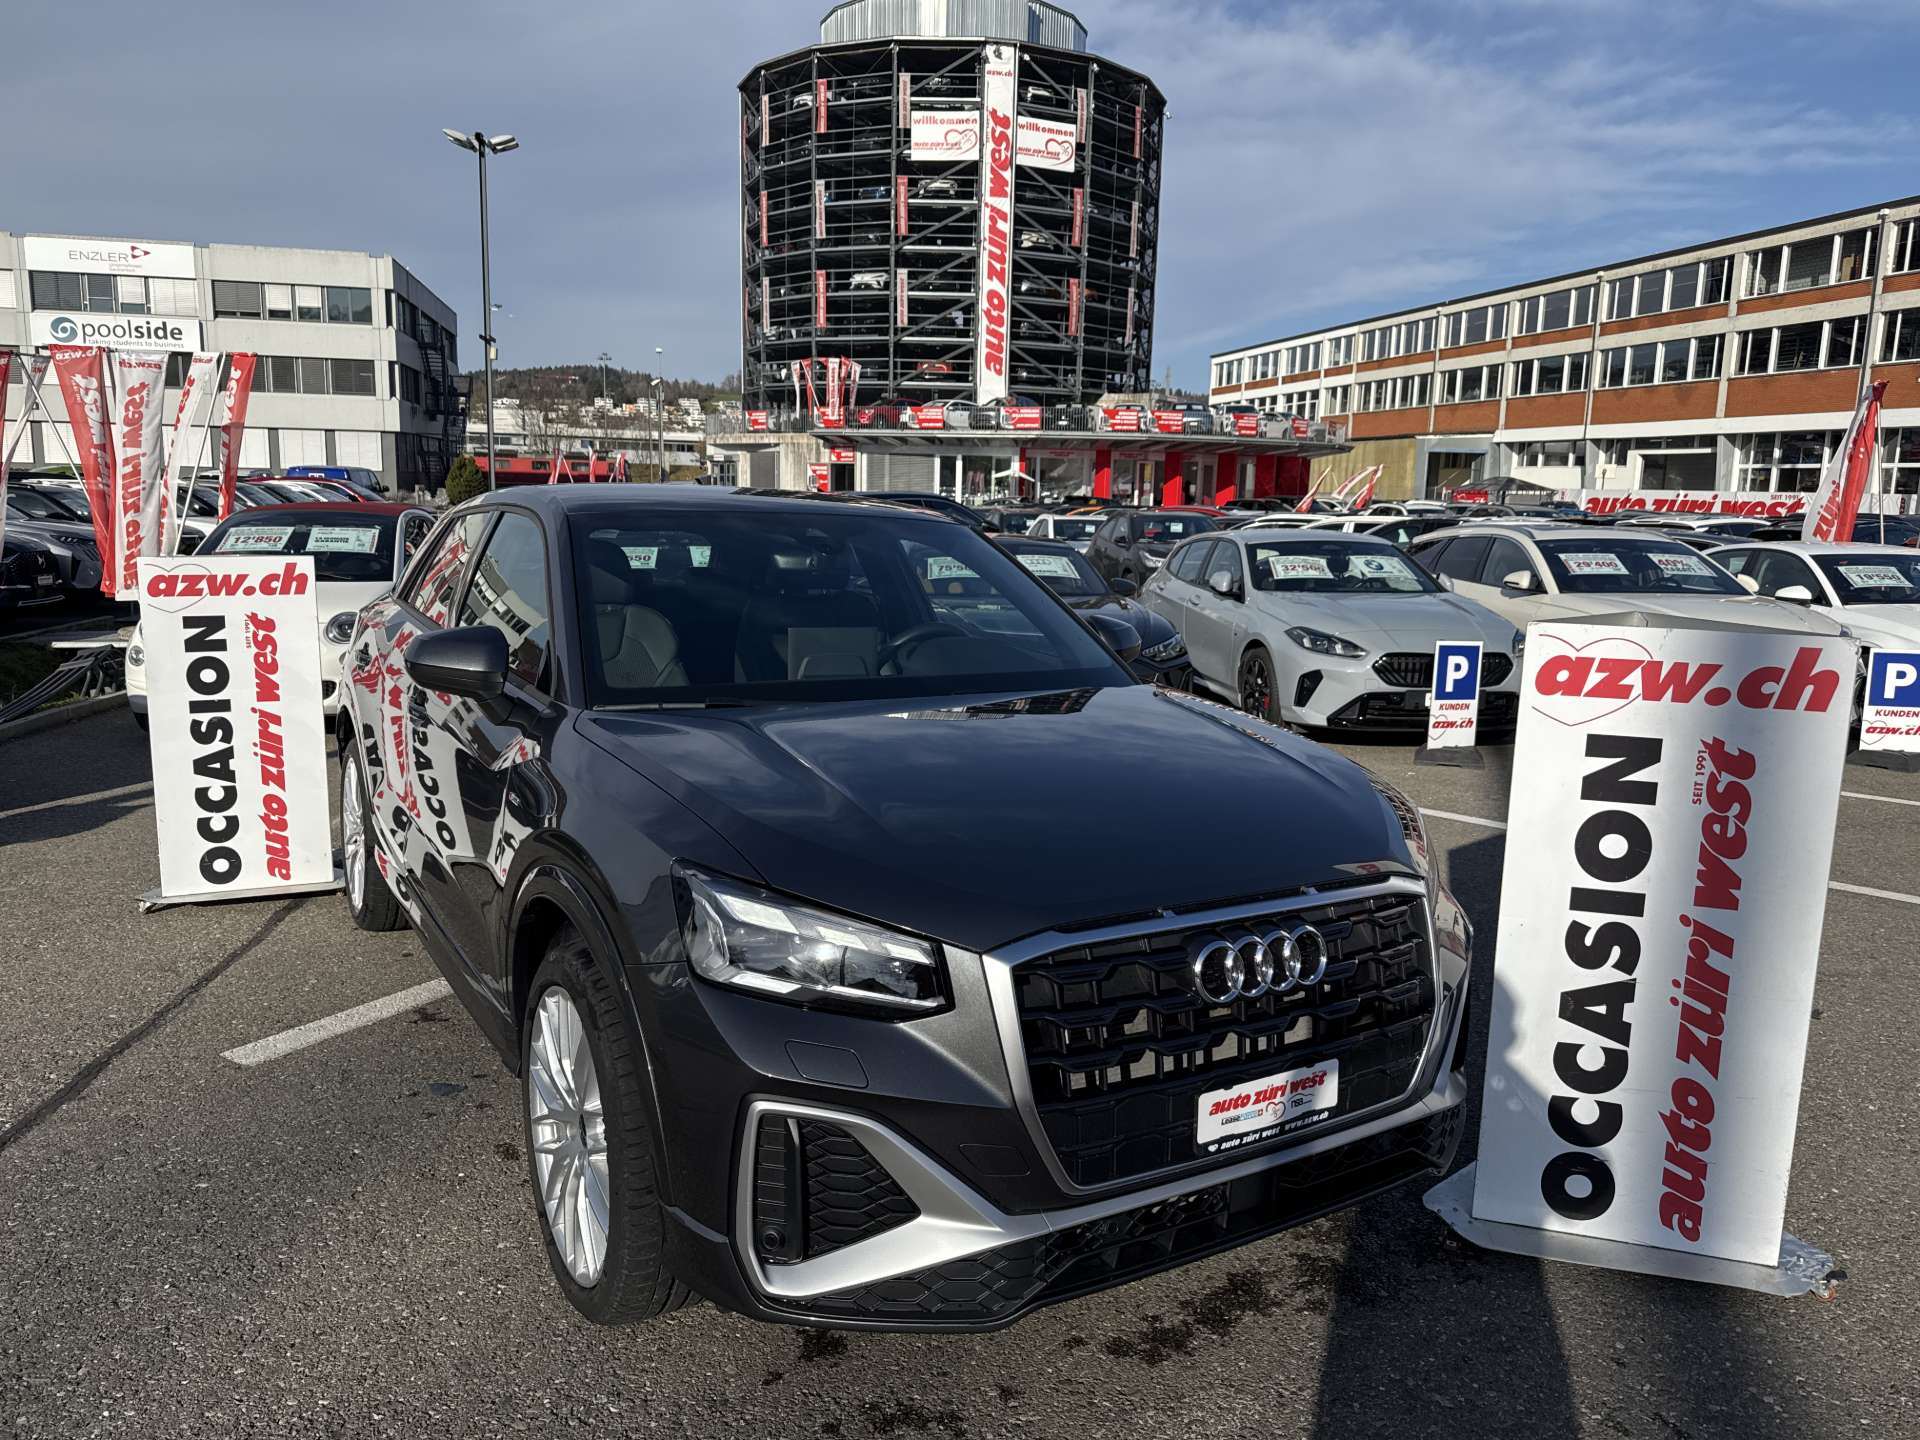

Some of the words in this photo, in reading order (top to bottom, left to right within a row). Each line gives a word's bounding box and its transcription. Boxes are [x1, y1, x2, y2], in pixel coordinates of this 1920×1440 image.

[912, 115, 978, 125] willkommen
[1018, 121, 1075, 138] willkommen
[988, 107, 1012, 199] west
[68, 250, 129, 263] ENZLER
[82, 319, 183, 344] poolside
[88, 338, 111, 347] taking
[113, 339, 142, 347] students
[154, 340, 184, 349] business
[984, 289, 1006, 377] auto
[1584, 494, 1646, 515] auto
[1720, 495, 1805, 517] west
[233, 535, 283, 544] 12'850
[146, 561, 309, 598] azw.ch
[245, 612, 281, 703] west
[1445, 655, 1469, 693] P
[1535, 647, 1840, 713] azw.ch
[1884, 662, 1918, 699] P
[1432, 718, 1474, 729] azw.ch
[1439, 703, 1471, 711] KUNDEN
[1875, 709, 1920, 718] KUNDEN
[182, 615, 242, 885] OCCASION
[250, 707, 286, 791] züri
[1696, 750, 1707, 776] 1991
[1692, 781, 1704, 805] SEIT
[256, 793, 292, 881] auto
[1694, 736, 1757, 912] west
[1540, 733, 1664, 1221] OCCASION
[1669, 913, 1738, 1081] züri
[1209, 1093, 1251, 1116] auto
[1251, 1080, 1290, 1105] züri
[1289, 1070, 1328, 1094] west
[1220, 1139, 1240, 1150] auto
[1261, 1126, 1281, 1139] west
[1657, 1077, 1717, 1242] auto
